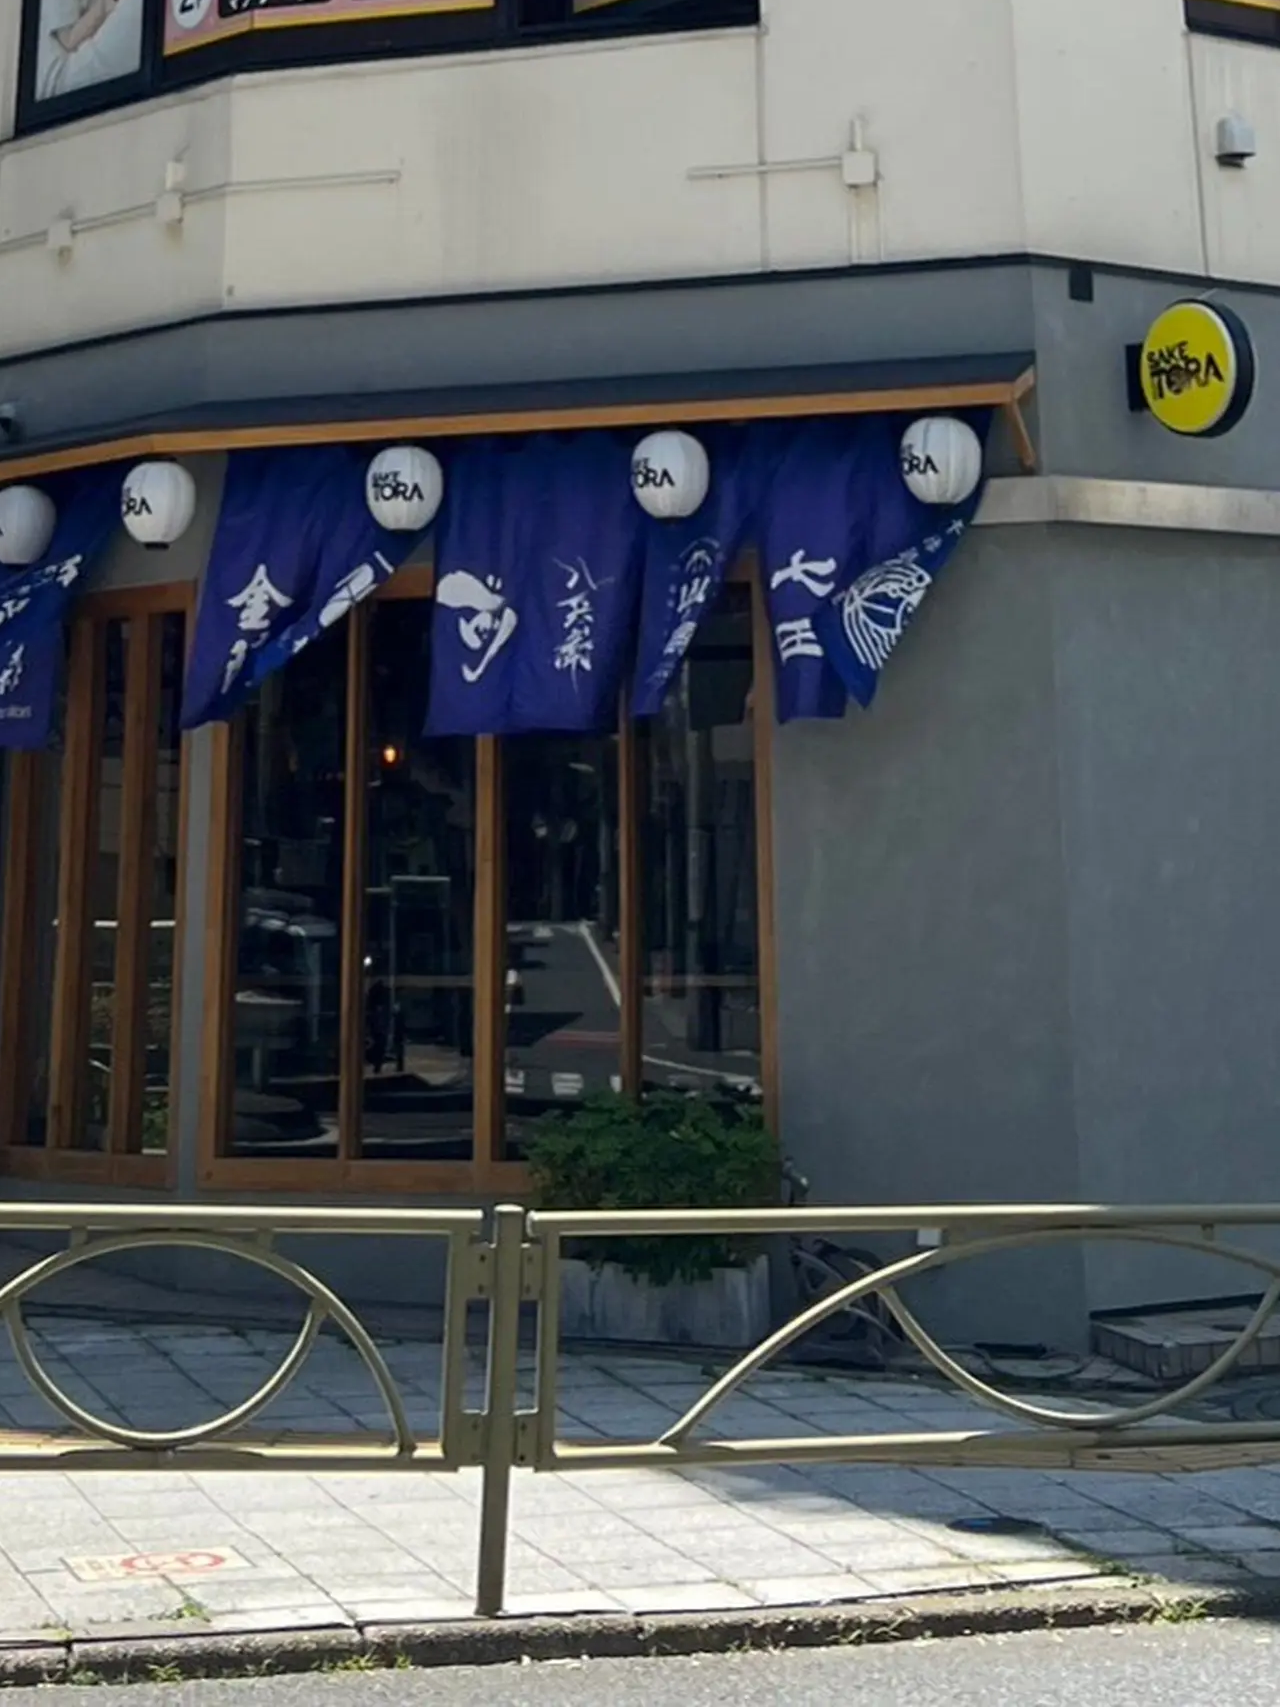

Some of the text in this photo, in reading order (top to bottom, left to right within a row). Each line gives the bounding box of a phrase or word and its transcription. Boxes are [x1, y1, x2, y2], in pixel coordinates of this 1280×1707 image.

[1150, 351, 1225, 400] TORA
[900, 454, 939, 477] ORA
[632, 467, 676, 489] ORA
[372, 481, 425, 503] TORA
[121, 495, 153, 517] ORA
